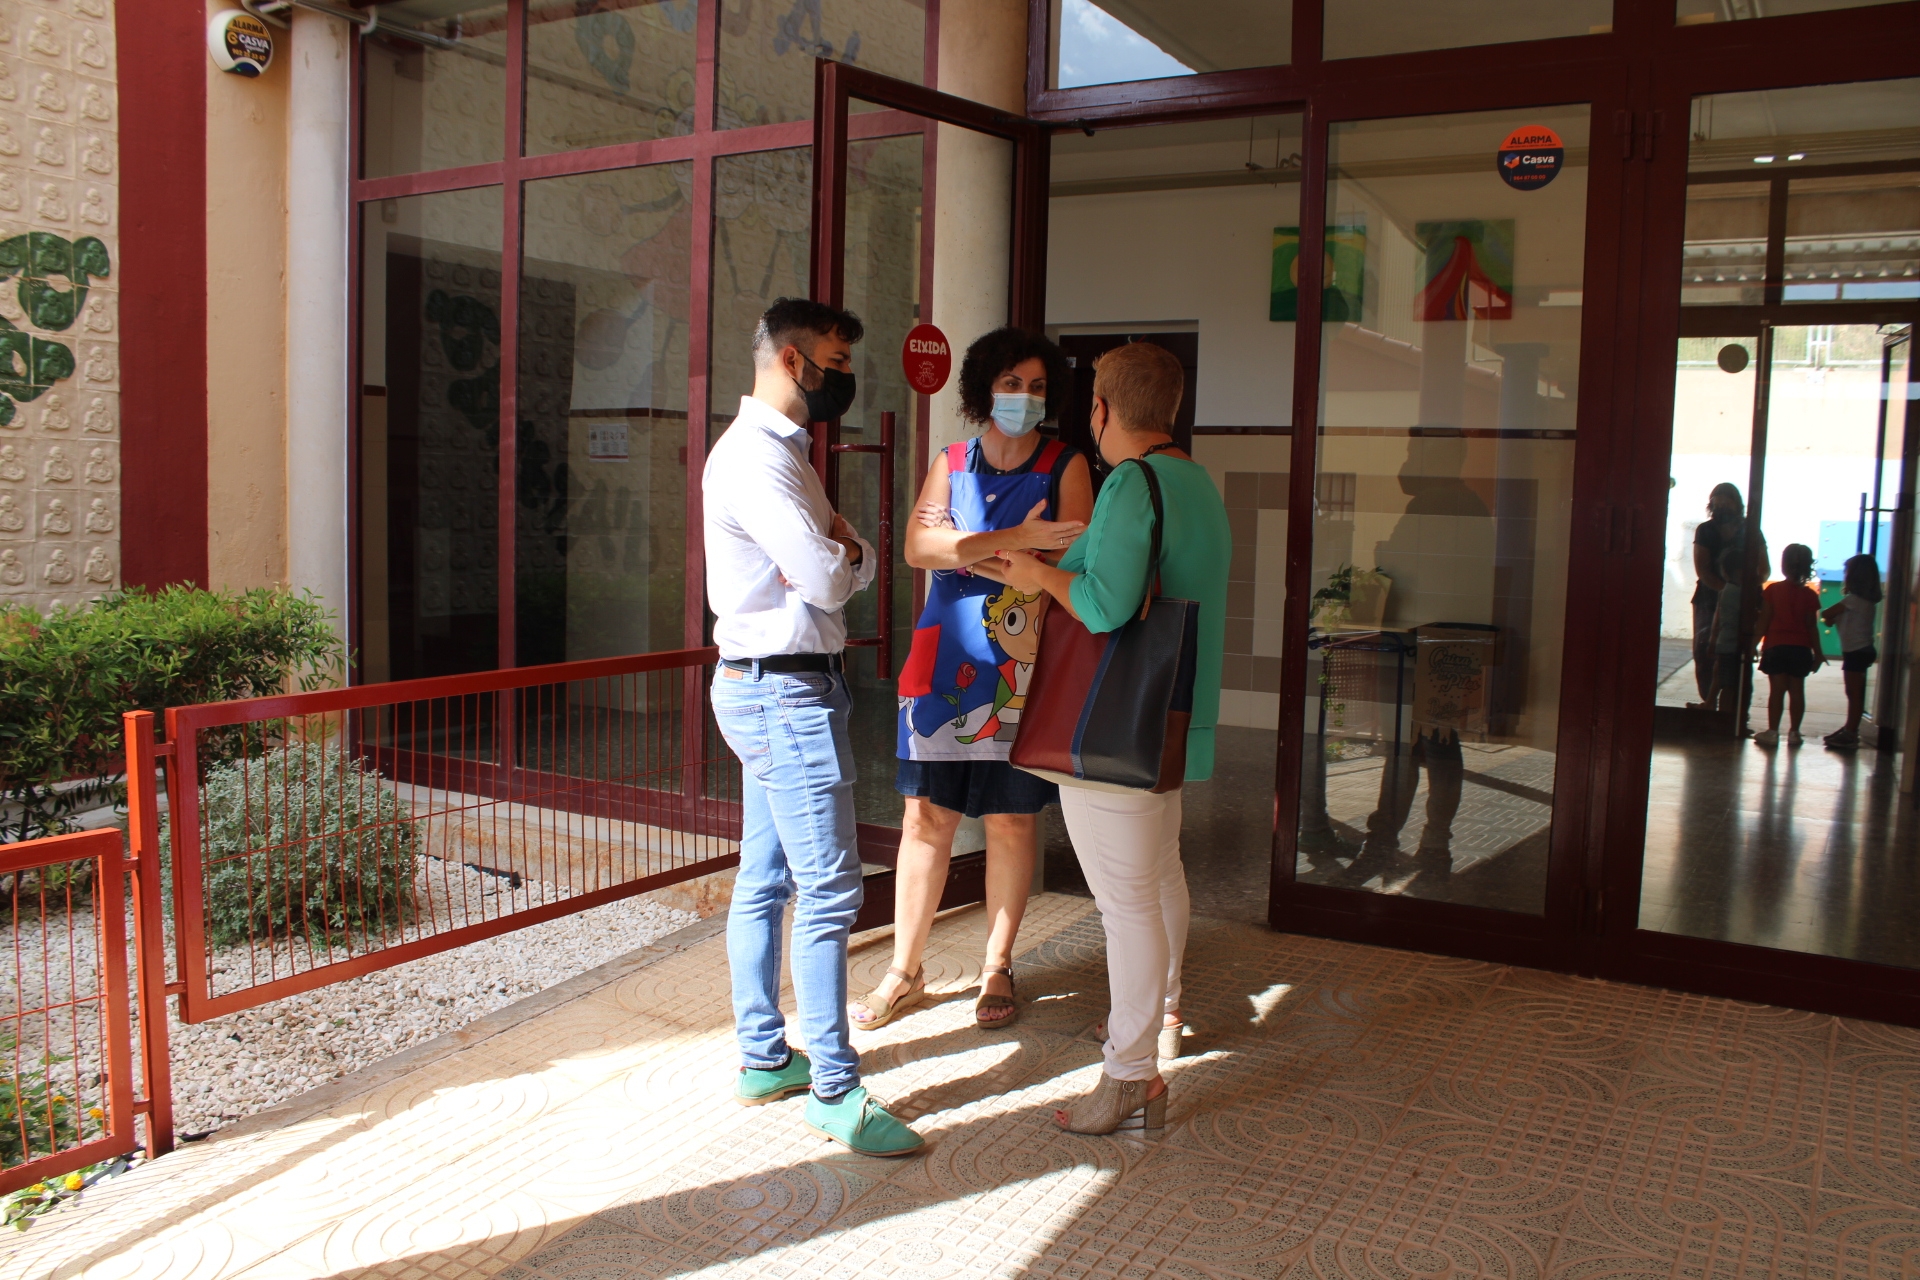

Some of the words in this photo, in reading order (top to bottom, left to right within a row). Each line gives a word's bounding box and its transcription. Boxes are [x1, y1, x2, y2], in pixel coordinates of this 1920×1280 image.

[232, 19, 264, 34] ALARMA
[238, 34, 270, 50] CASVA
[1510, 135, 1552, 145] ALARMA
[1522, 155, 1555, 164] Casva
[909, 339, 947, 355] EIXIDA
[1440, 672, 1482, 692] Piles
